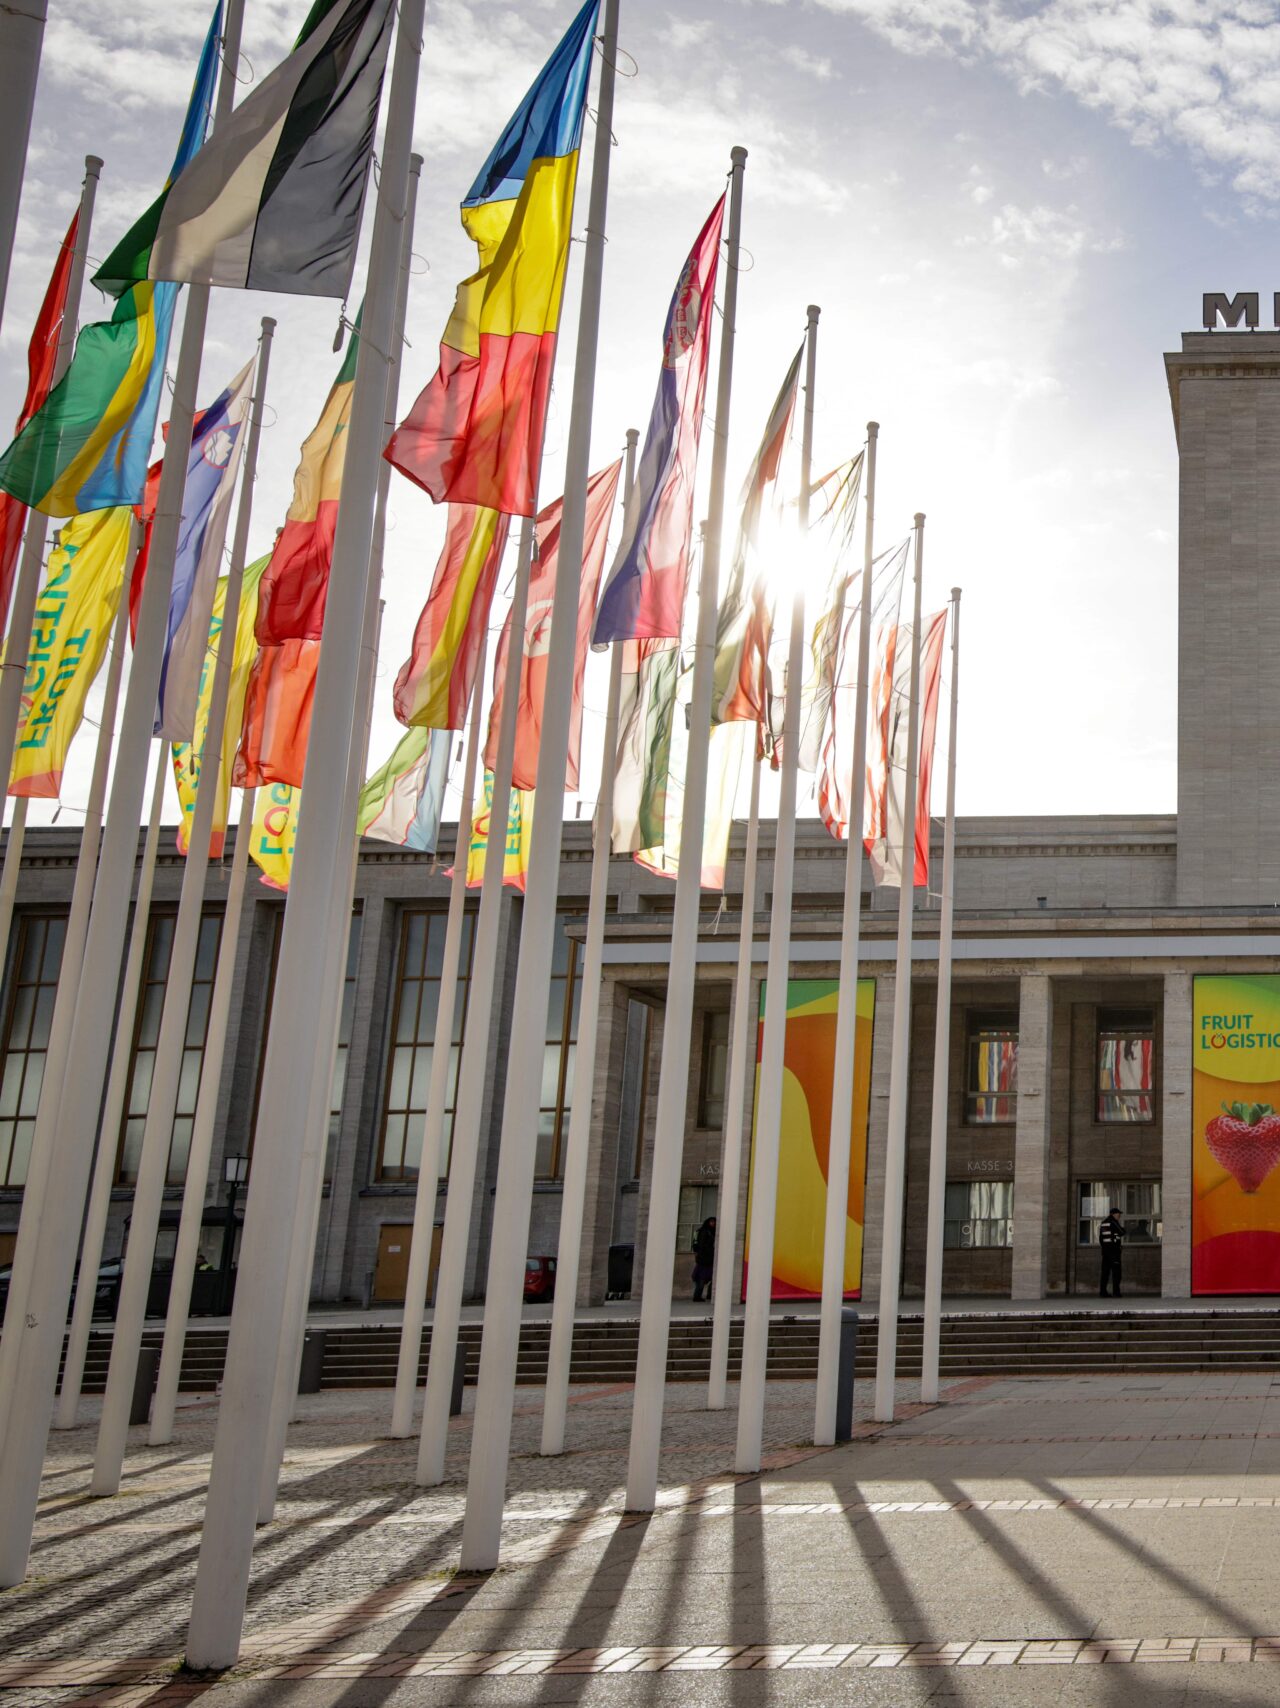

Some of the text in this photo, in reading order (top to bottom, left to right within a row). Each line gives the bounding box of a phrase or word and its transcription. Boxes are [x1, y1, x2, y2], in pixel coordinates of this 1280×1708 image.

[1201, 1014, 1254, 1030] FRUIT
[700, 1163, 720, 1175] KAS
[967, 1160, 1013, 1171] KASSE 3
